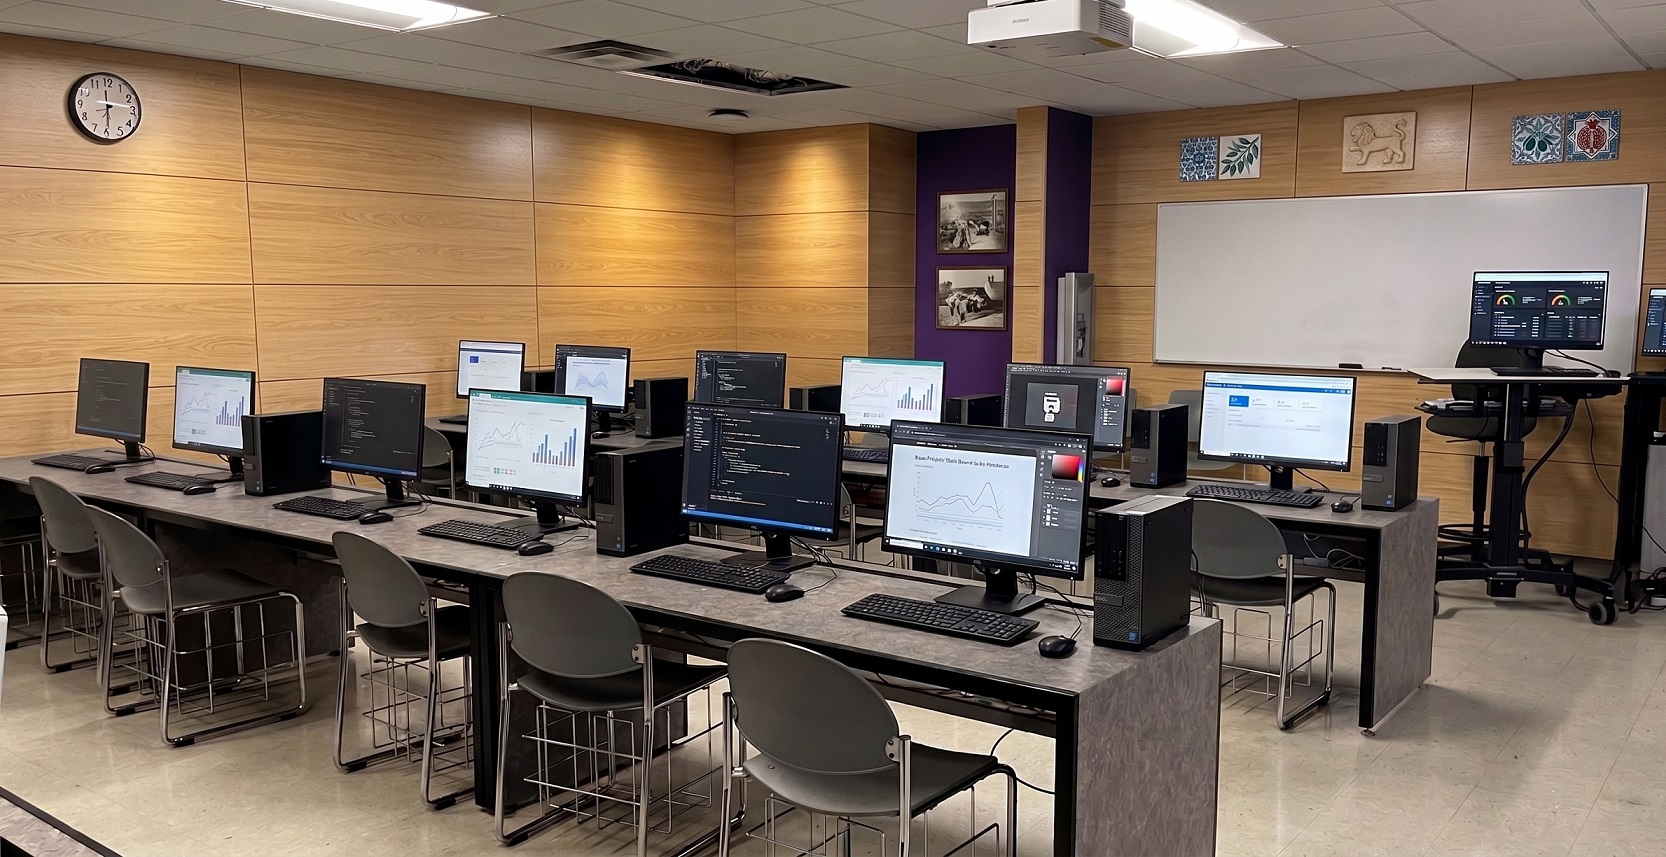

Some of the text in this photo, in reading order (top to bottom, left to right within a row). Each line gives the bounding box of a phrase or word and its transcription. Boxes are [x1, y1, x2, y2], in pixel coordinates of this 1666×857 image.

[90, 78, 98, 90] 11
[102, 78, 112, 88] 12
[118, 84, 122, 94] 1
[77, 99, 84, 108] 9
[126, 94, 132, 104] 2
[82, 112, 88, 120] 8
[130, 106, 136, 116] 3
[92, 122, 98, 132] 7
[126, 118, 132, 128] 4
[116, 126, 124, 136] 5
